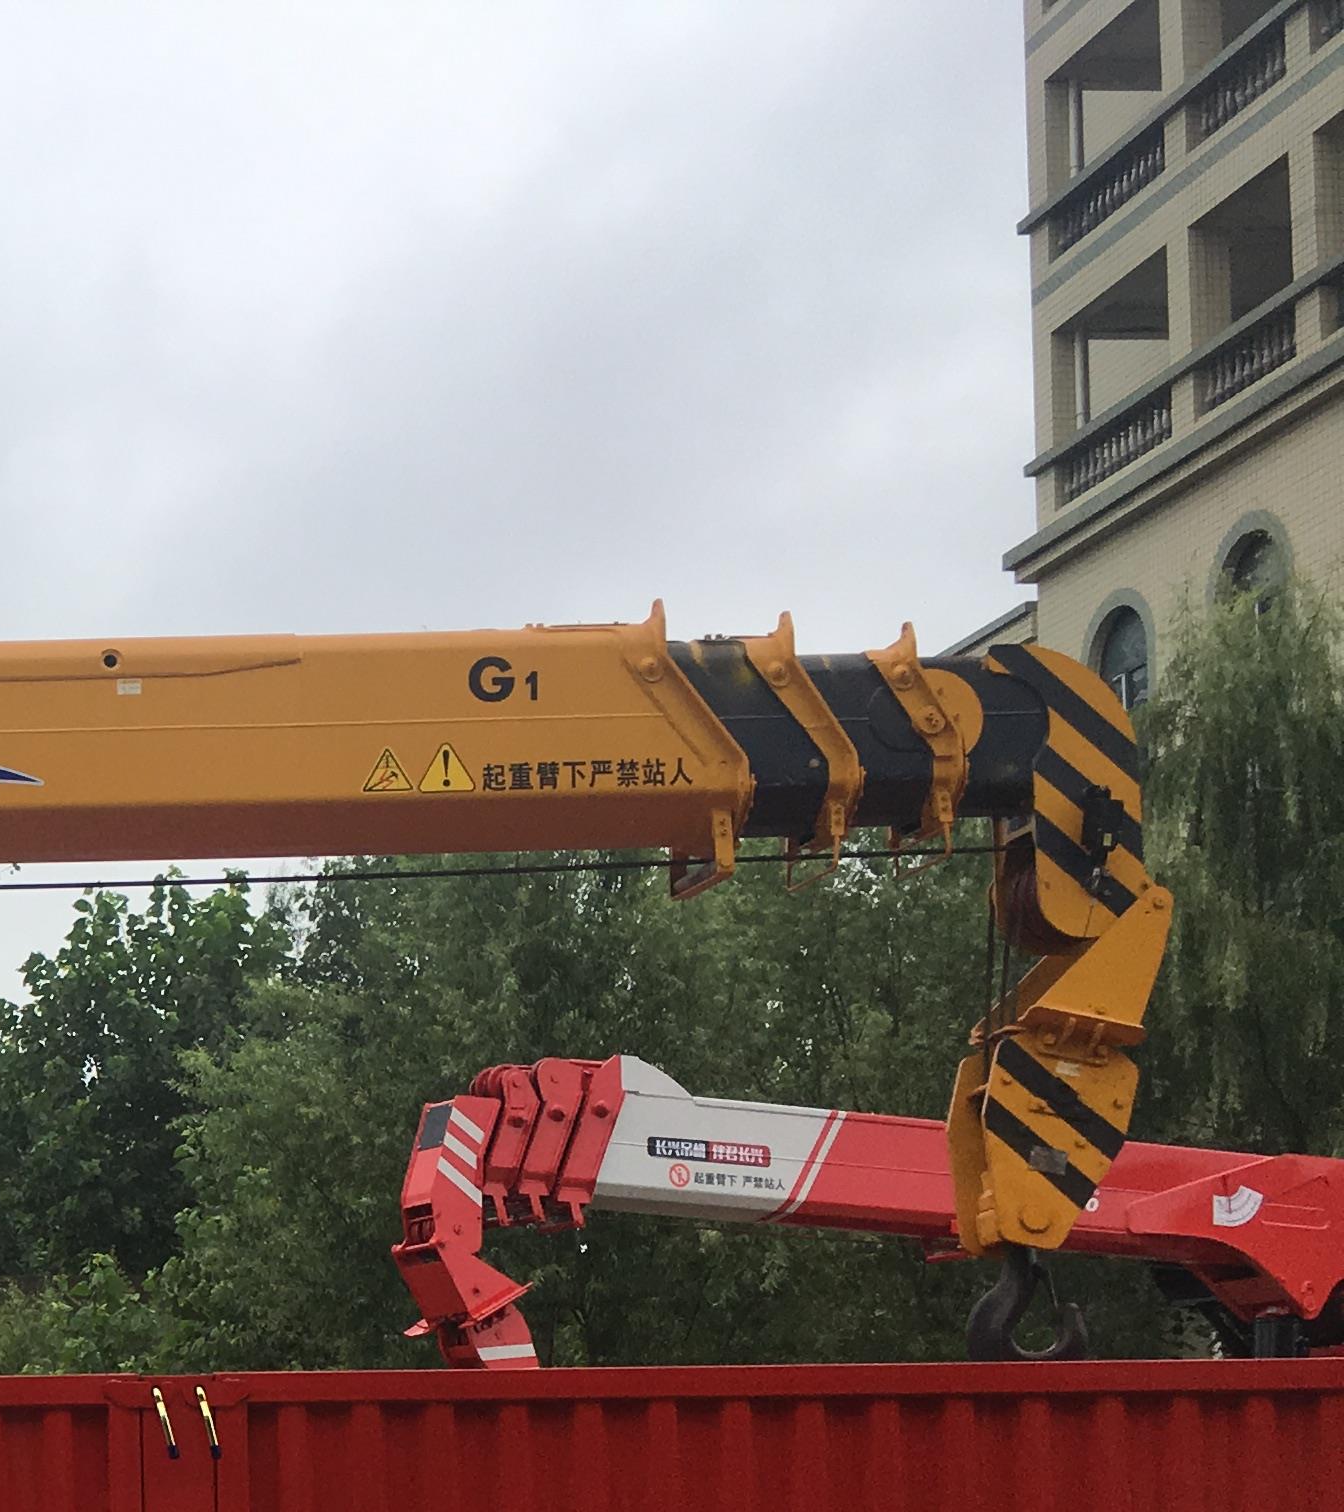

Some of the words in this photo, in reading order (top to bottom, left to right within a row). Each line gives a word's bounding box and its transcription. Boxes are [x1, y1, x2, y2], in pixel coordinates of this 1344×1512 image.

[469, 656, 539, 702] G1
[481, 757, 694, 792] 起重臂下严禁站人
